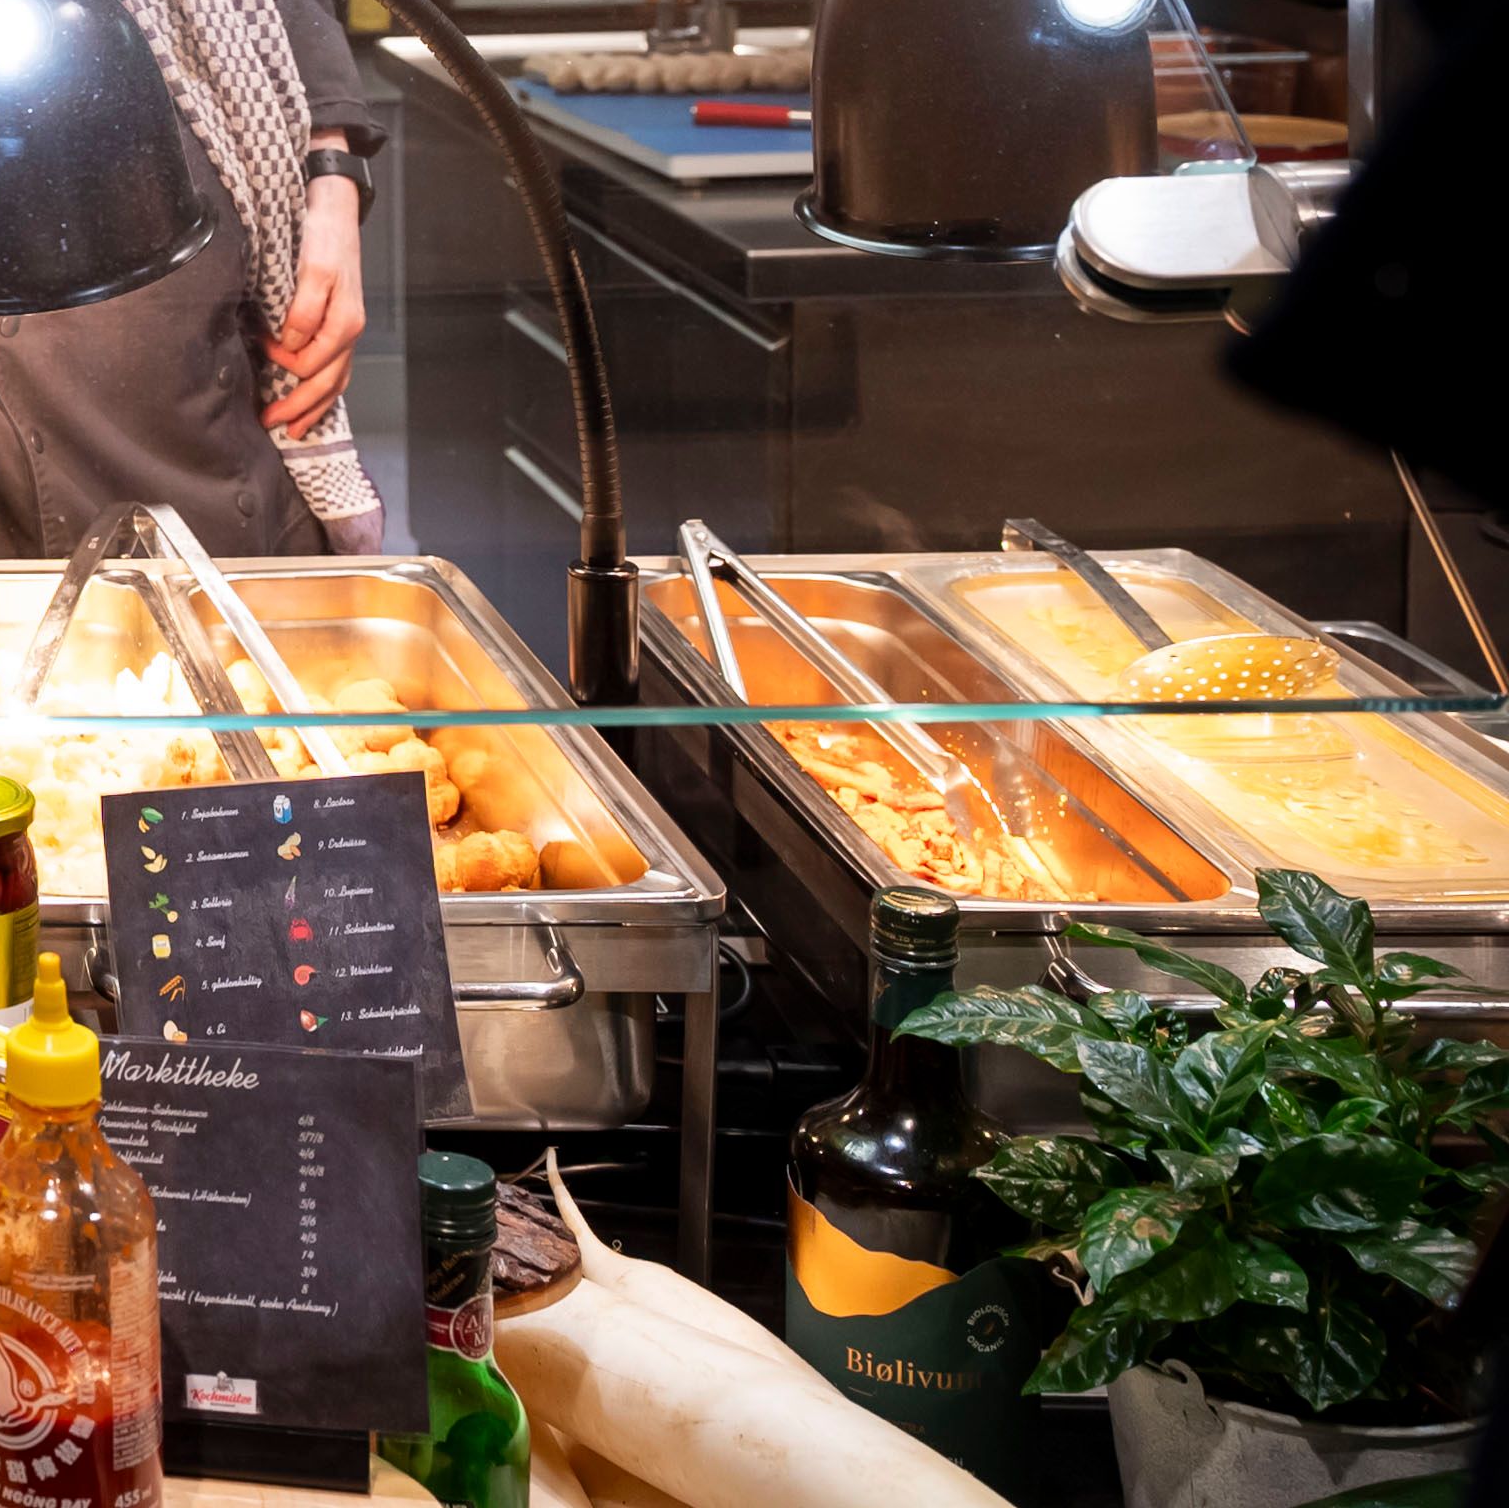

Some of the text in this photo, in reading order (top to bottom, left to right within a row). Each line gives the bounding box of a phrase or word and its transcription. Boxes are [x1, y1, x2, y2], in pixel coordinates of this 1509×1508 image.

[99, 1049, 260, 1090] Markttheke
[966, 1335, 1005, 1353] ORGANIC
[114, 1488, 141, 1508] 455
